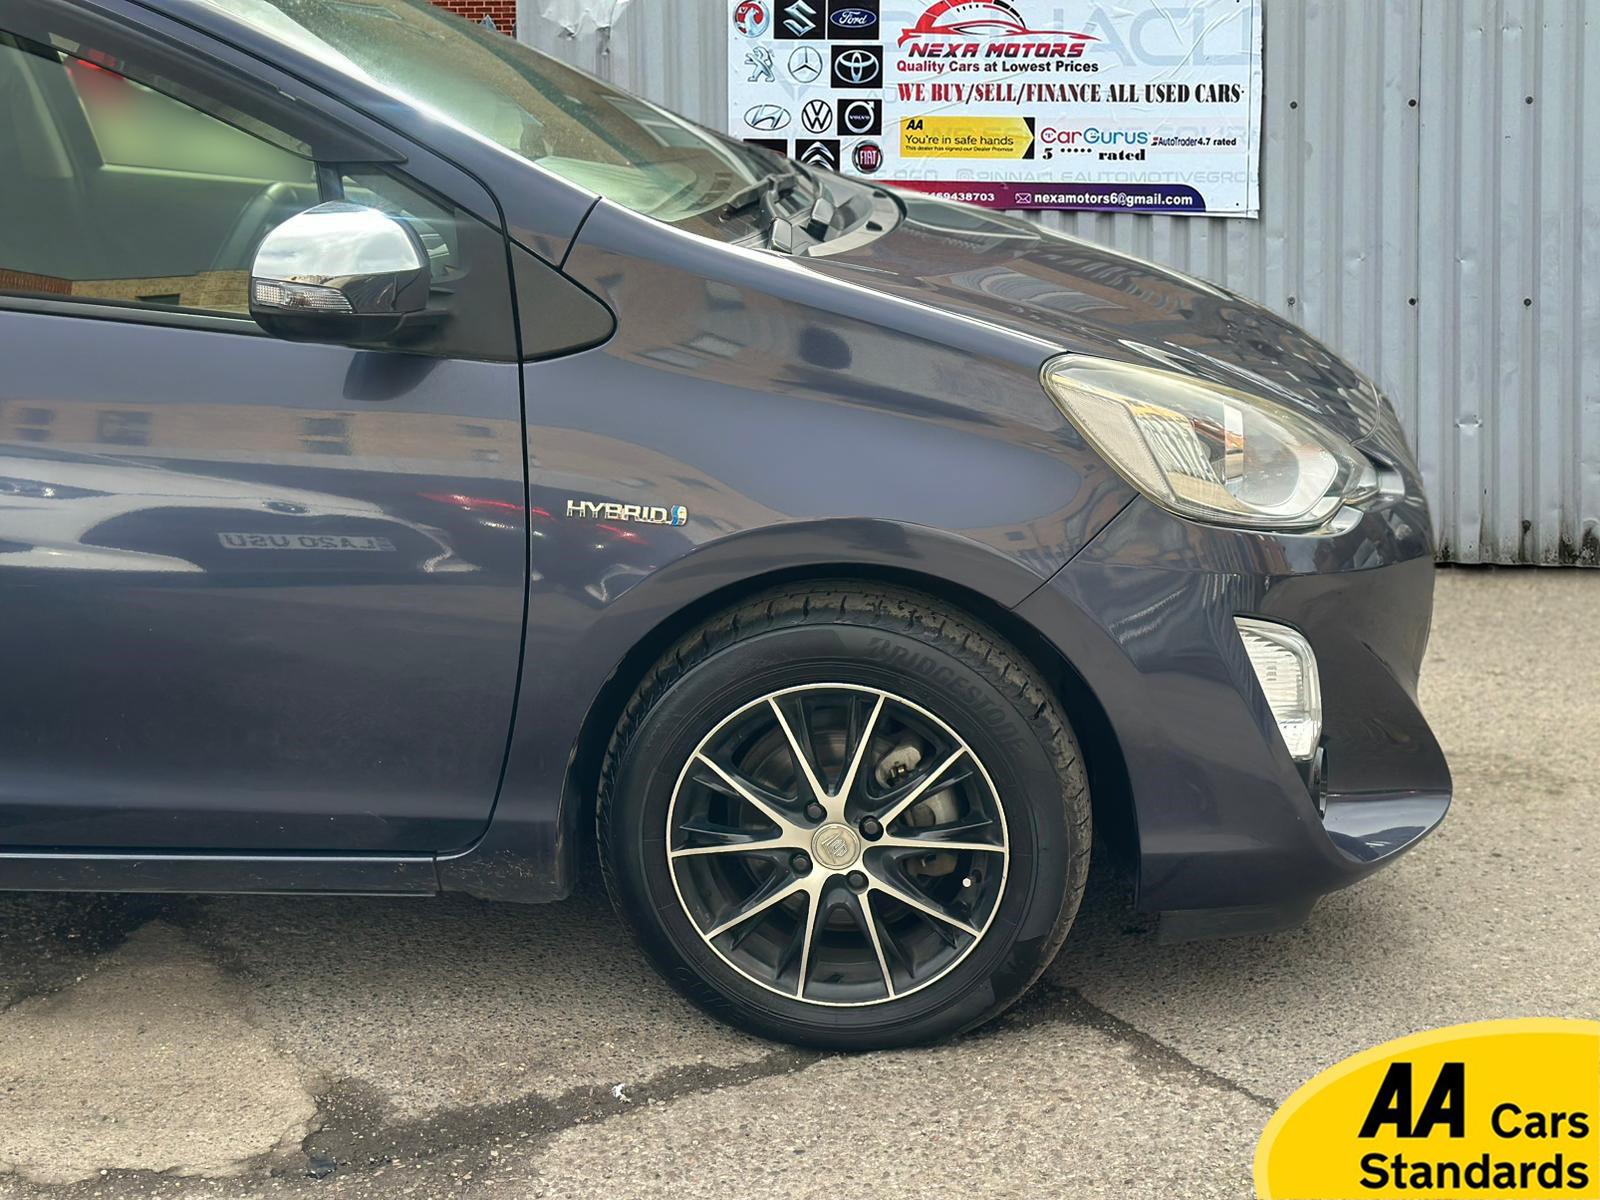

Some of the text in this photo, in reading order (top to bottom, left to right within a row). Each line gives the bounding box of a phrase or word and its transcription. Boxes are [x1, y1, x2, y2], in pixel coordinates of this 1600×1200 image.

[839, 11, 868, 25] Ford
[908, 43, 1086, 58] NEXA MOTORS
[896, 61, 1099, 74] Quality Cars at Lowest Prices
[897, 83, 925, 102] WE
[931, 83, 1101, 105] BUY/SELL/FINANCE
[1106, 84, 1140, 103] ALL
[1145, 84, 1190, 103] USED
[906, 119, 924, 131] AA
[905, 134, 1014, 146] You're in safe hands
[1040, 127, 1149, 145] CarGurus
[1213, 137, 1237, 146] rated
[860, 150, 877, 165] FIAT
[1098, 149, 1146, 161] rated
[1034, 193, 1193, 207] nexamotors6@gmail.com
[566, 499, 669, 523] HYBRID
